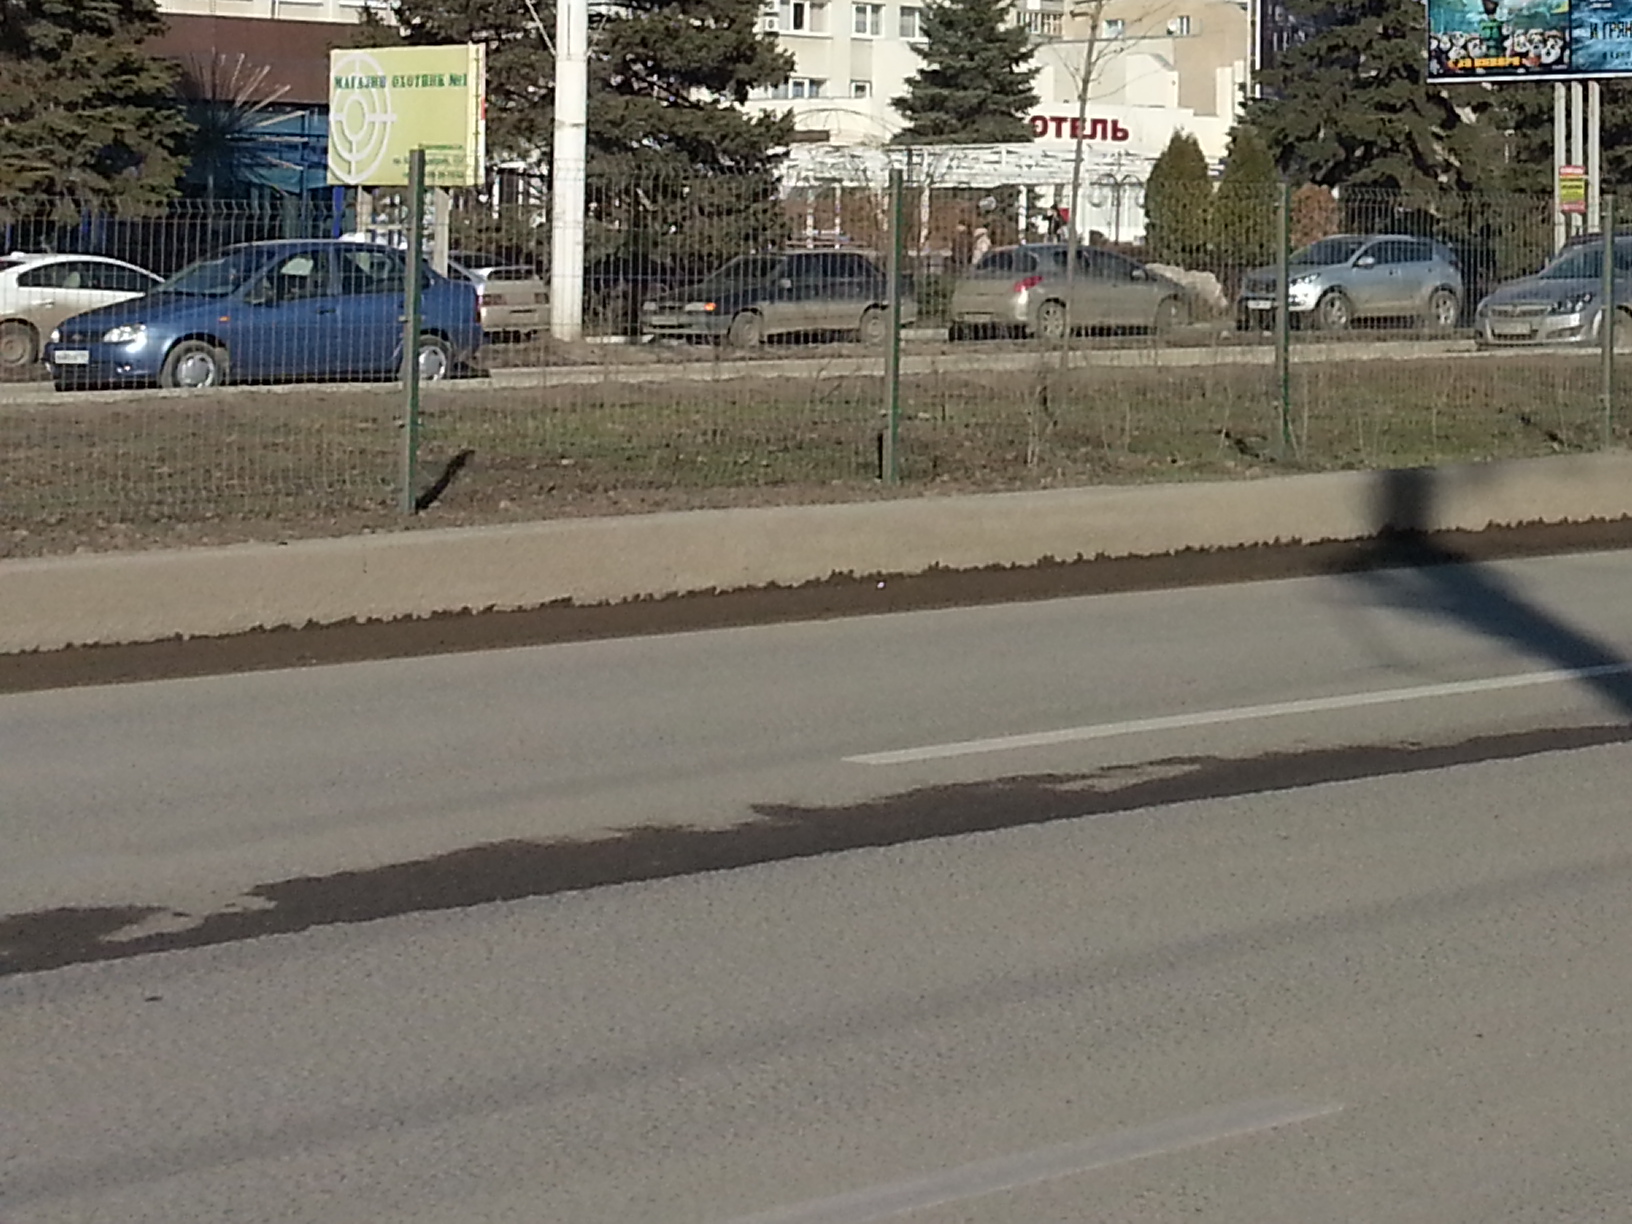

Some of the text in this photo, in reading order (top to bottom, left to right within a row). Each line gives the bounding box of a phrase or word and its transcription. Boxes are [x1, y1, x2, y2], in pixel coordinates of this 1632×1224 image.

[334, 76, 387, 89] МАГАЗИН
[392, 75, 446, 88] ОХОТНИК
[1030, 115, 1129, 142] ОТЕЛЬ
